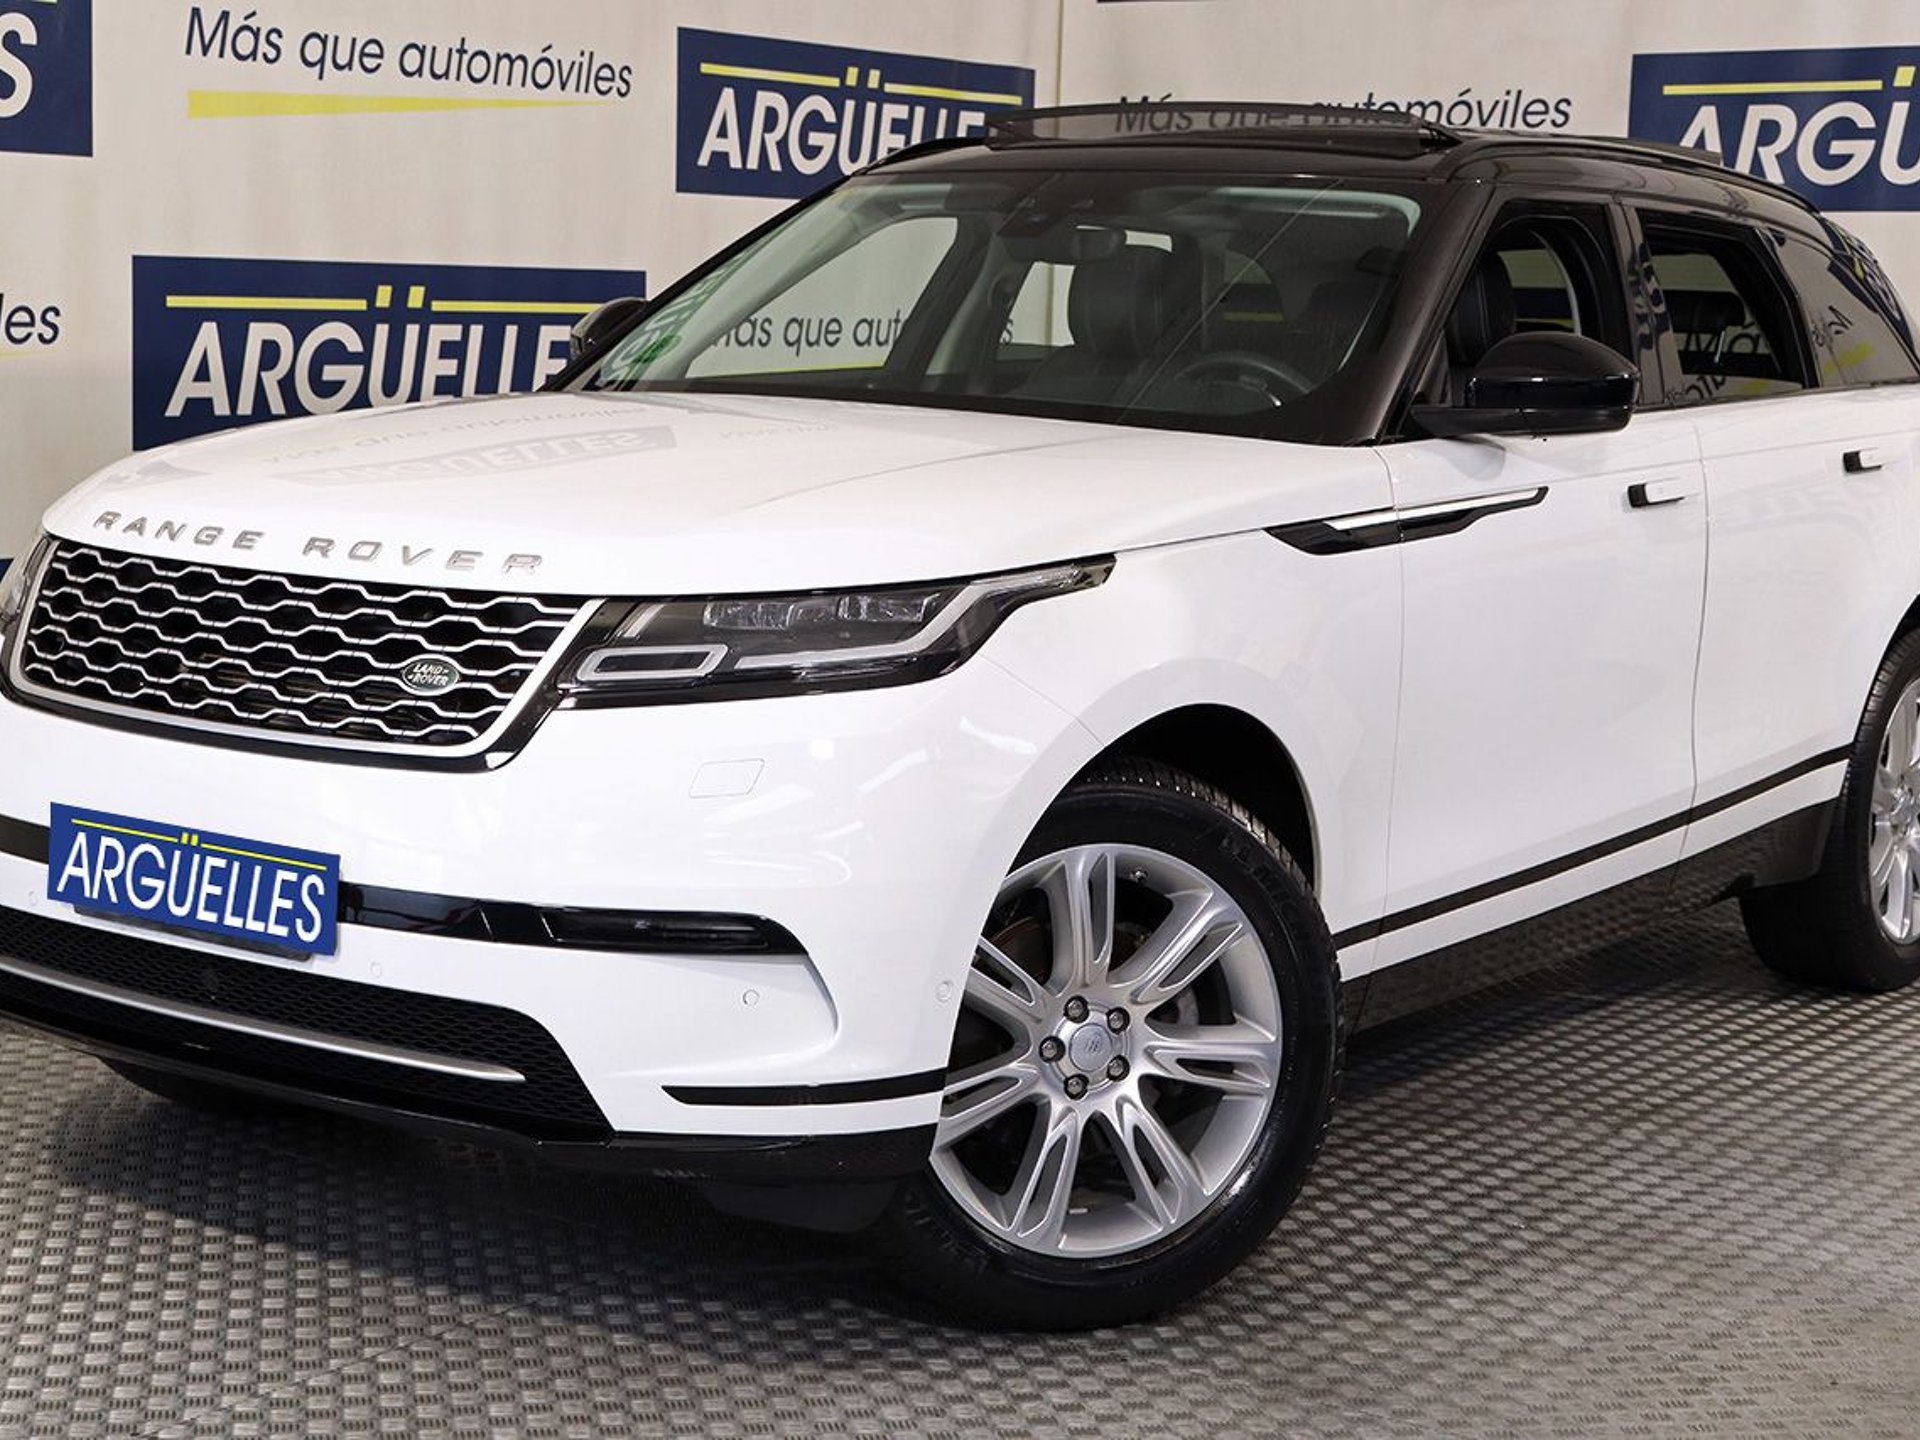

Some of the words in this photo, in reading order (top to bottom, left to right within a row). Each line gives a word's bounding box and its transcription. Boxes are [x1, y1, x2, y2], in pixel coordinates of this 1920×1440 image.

[185, 6, 283, 64] Más
[299, 31, 385, 81] que
[398, 37, 633, 98] automóviles
[783, 316, 843, 357] que
[93, 510, 265, 551] RANGE
[302, 536, 542, 574] ROVER
[56, 831, 326, 944] ARGÜELLES
